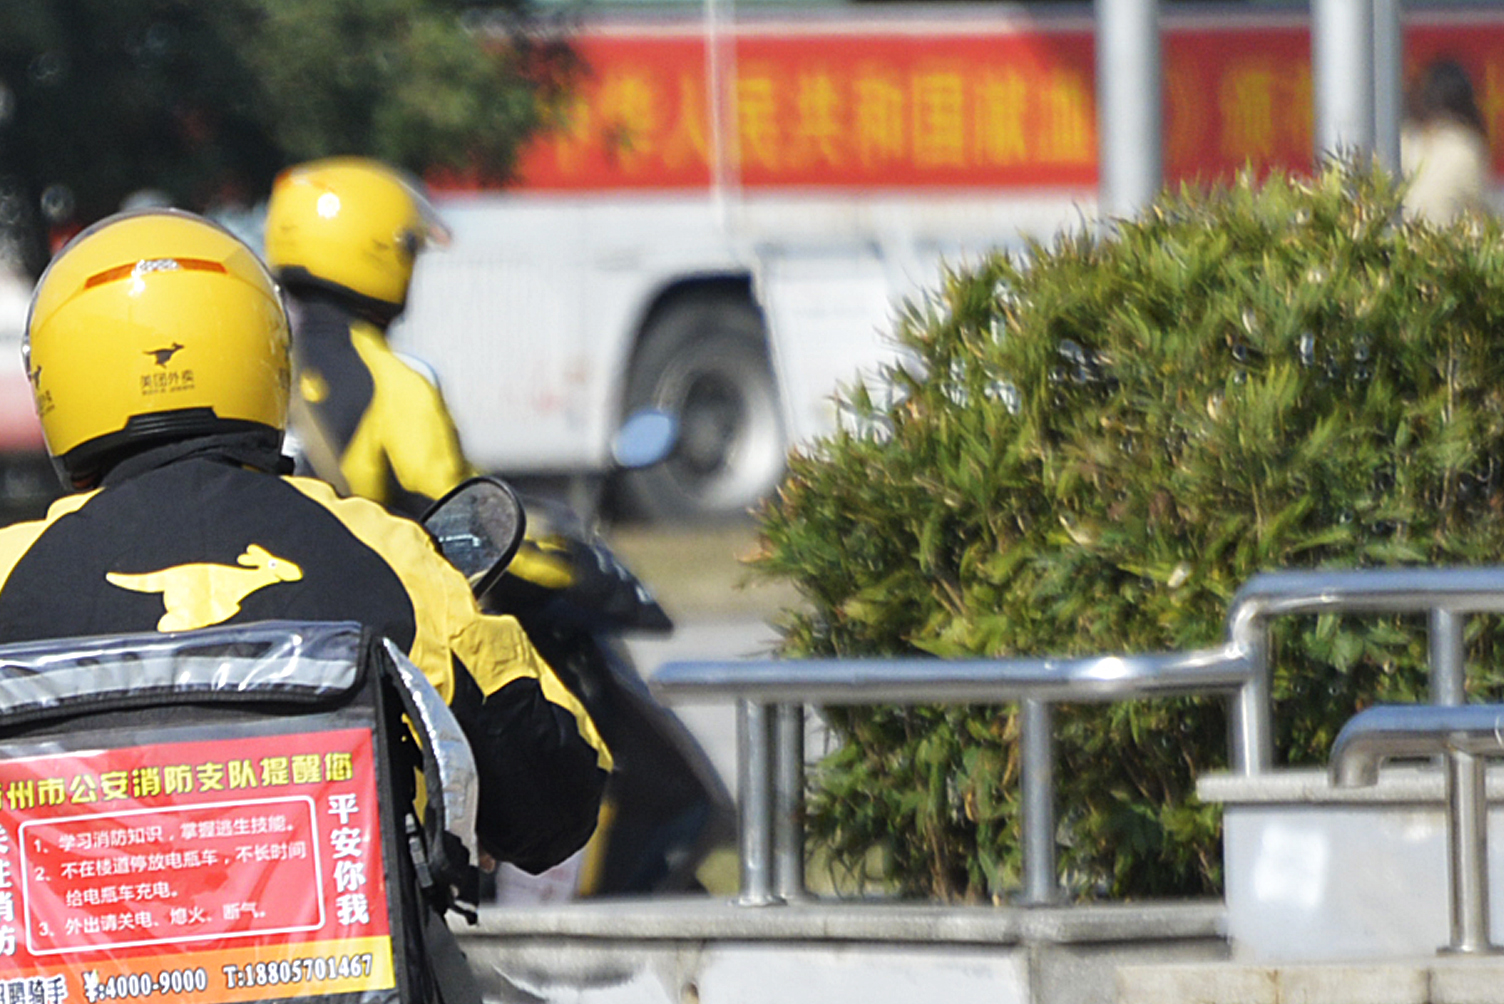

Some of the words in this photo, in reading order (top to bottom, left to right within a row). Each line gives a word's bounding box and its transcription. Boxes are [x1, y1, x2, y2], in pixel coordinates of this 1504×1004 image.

[328, 792, 370, 927] 平安你我
[221, 952, 375, 991] T:18805701467
